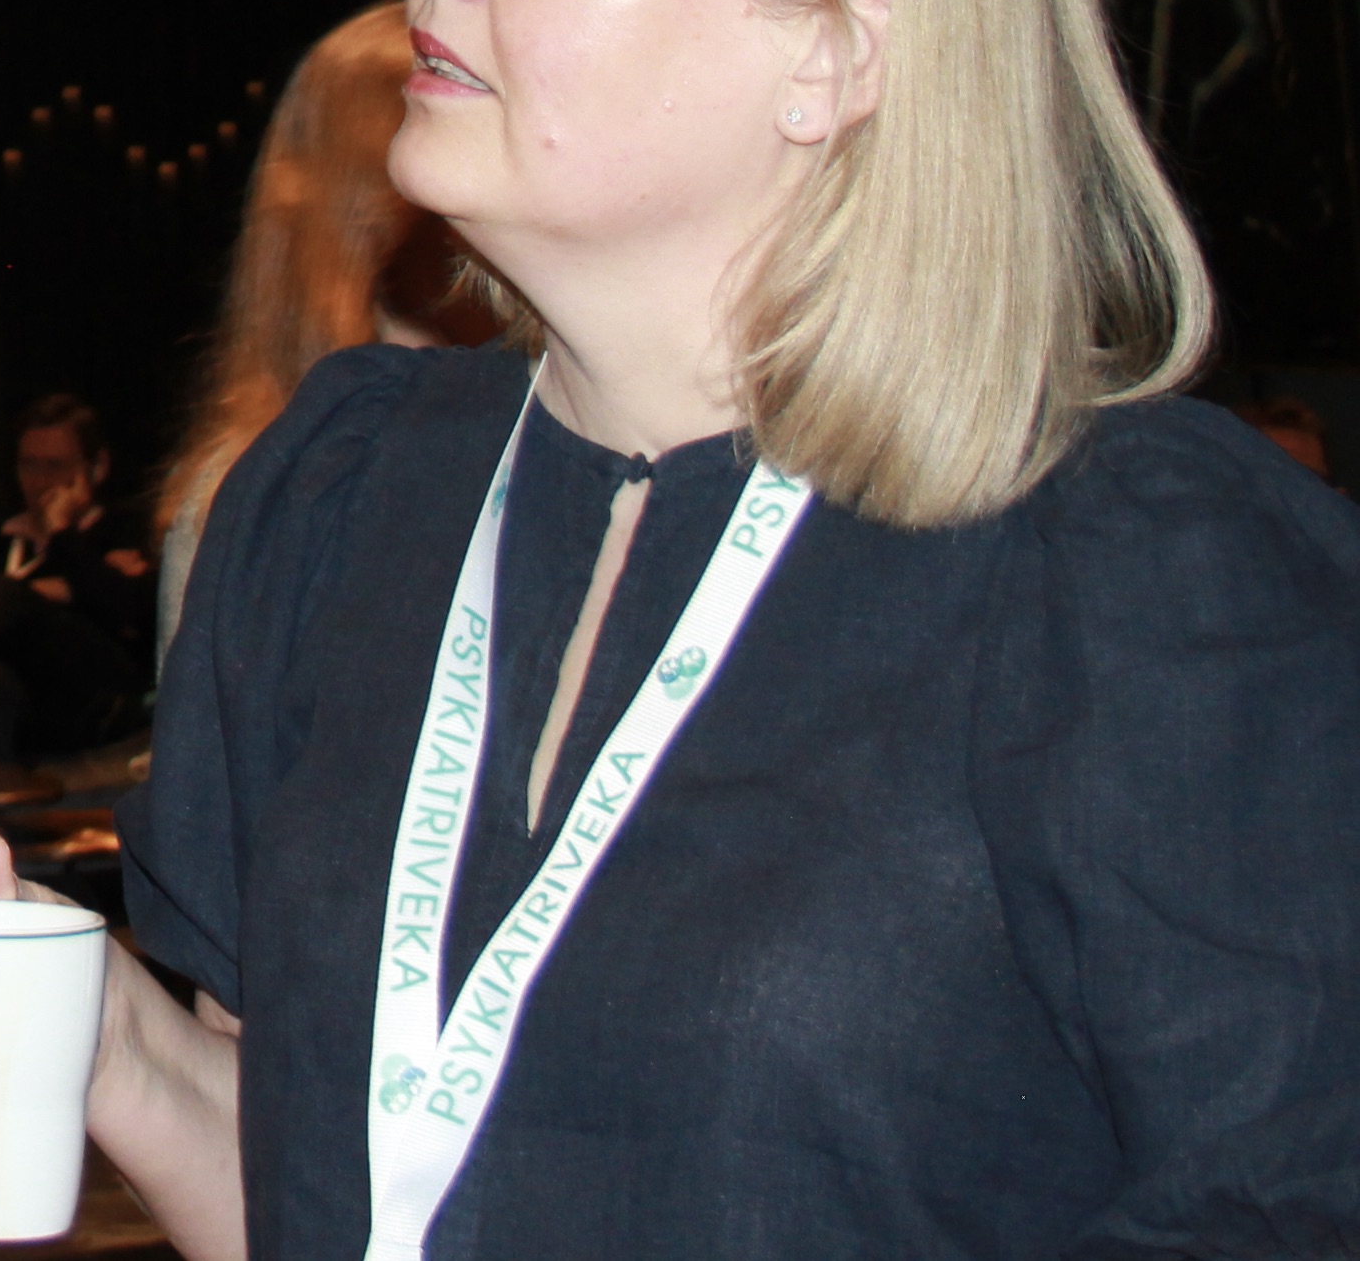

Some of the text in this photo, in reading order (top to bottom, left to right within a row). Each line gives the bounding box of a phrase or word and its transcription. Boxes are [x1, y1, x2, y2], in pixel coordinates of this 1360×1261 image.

[730, 465, 800, 558] PSY
[391, 606, 488, 993] PSYKIATRIVEKA
[426, 752, 646, 1125] PSYKIATRIVEKA
